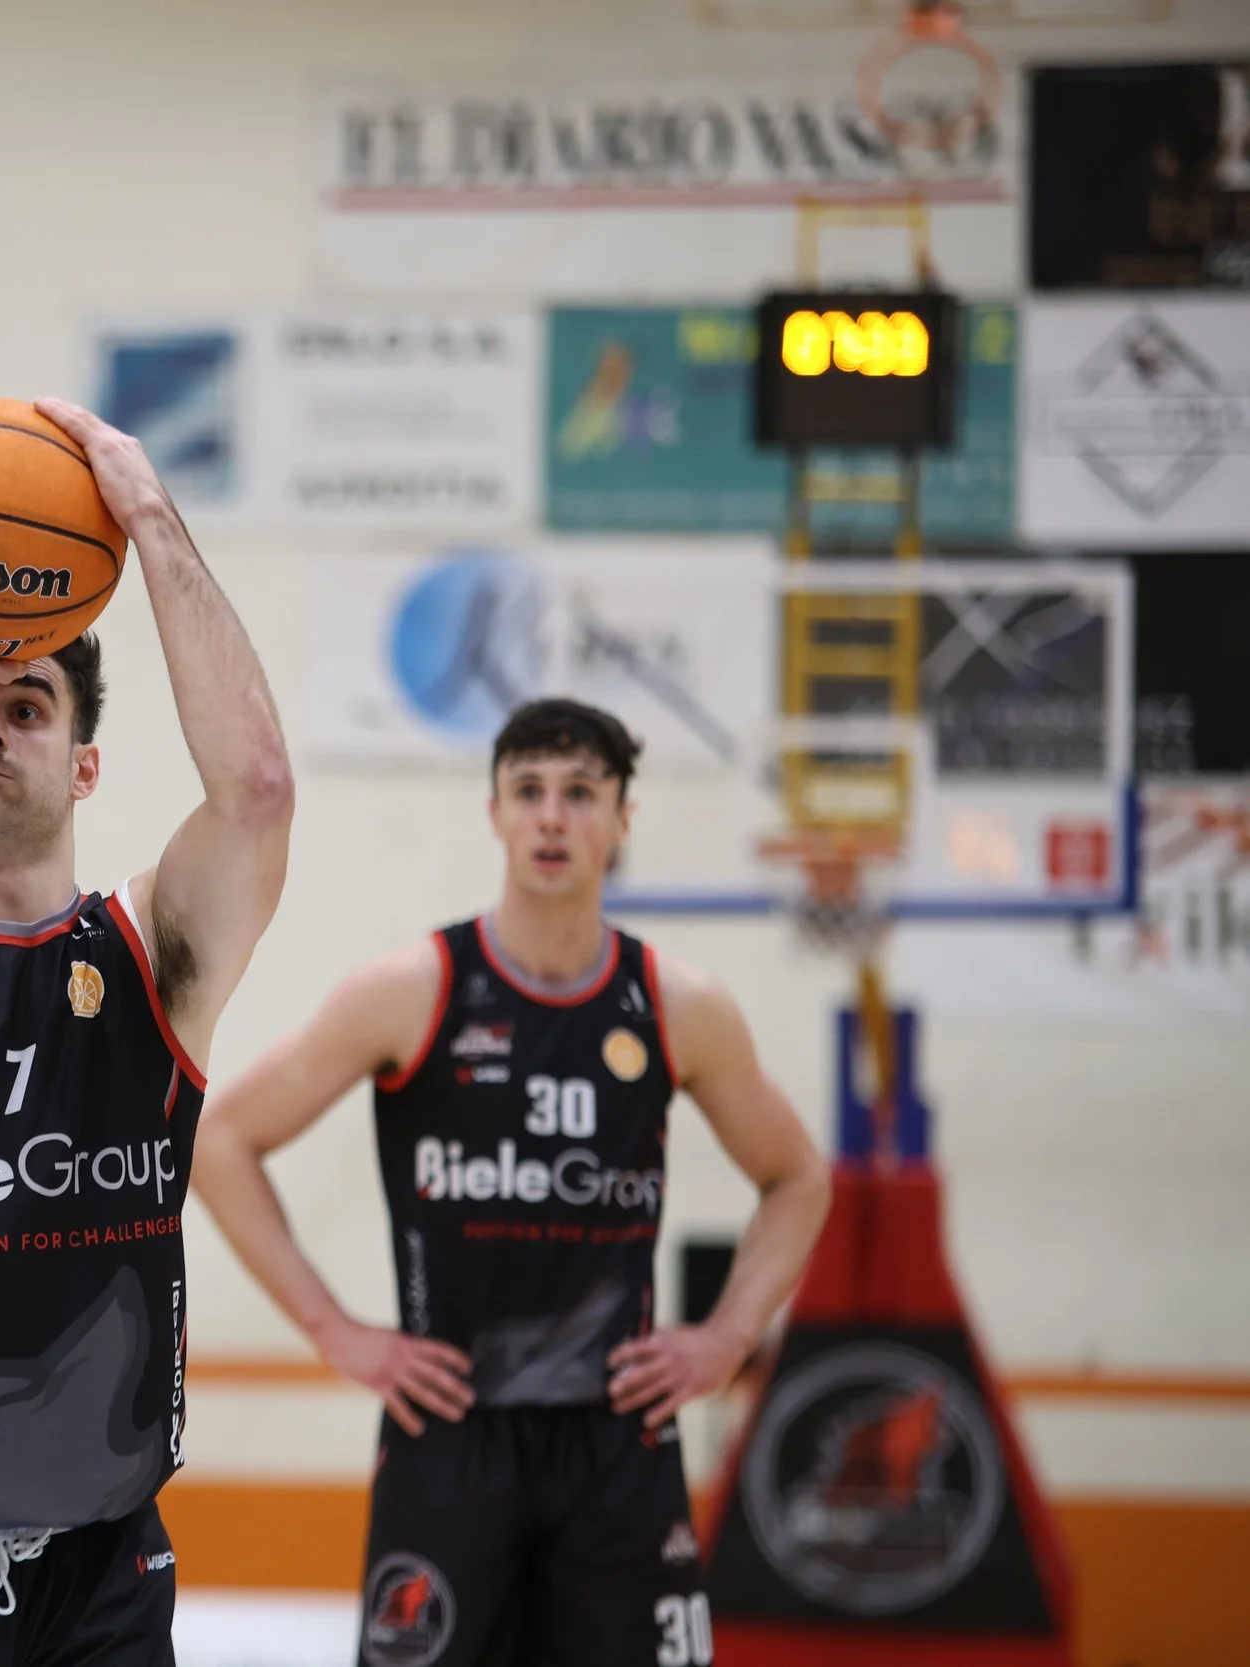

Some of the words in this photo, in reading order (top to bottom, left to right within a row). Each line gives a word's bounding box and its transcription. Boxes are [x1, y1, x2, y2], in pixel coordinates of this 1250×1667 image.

[524, 1074, 597, 1138] 30
[21, 1232, 62, 1250] FOR
[68, 1215, 180, 1247] CHALLENGES
[654, 1591, 713, 1667] 30
